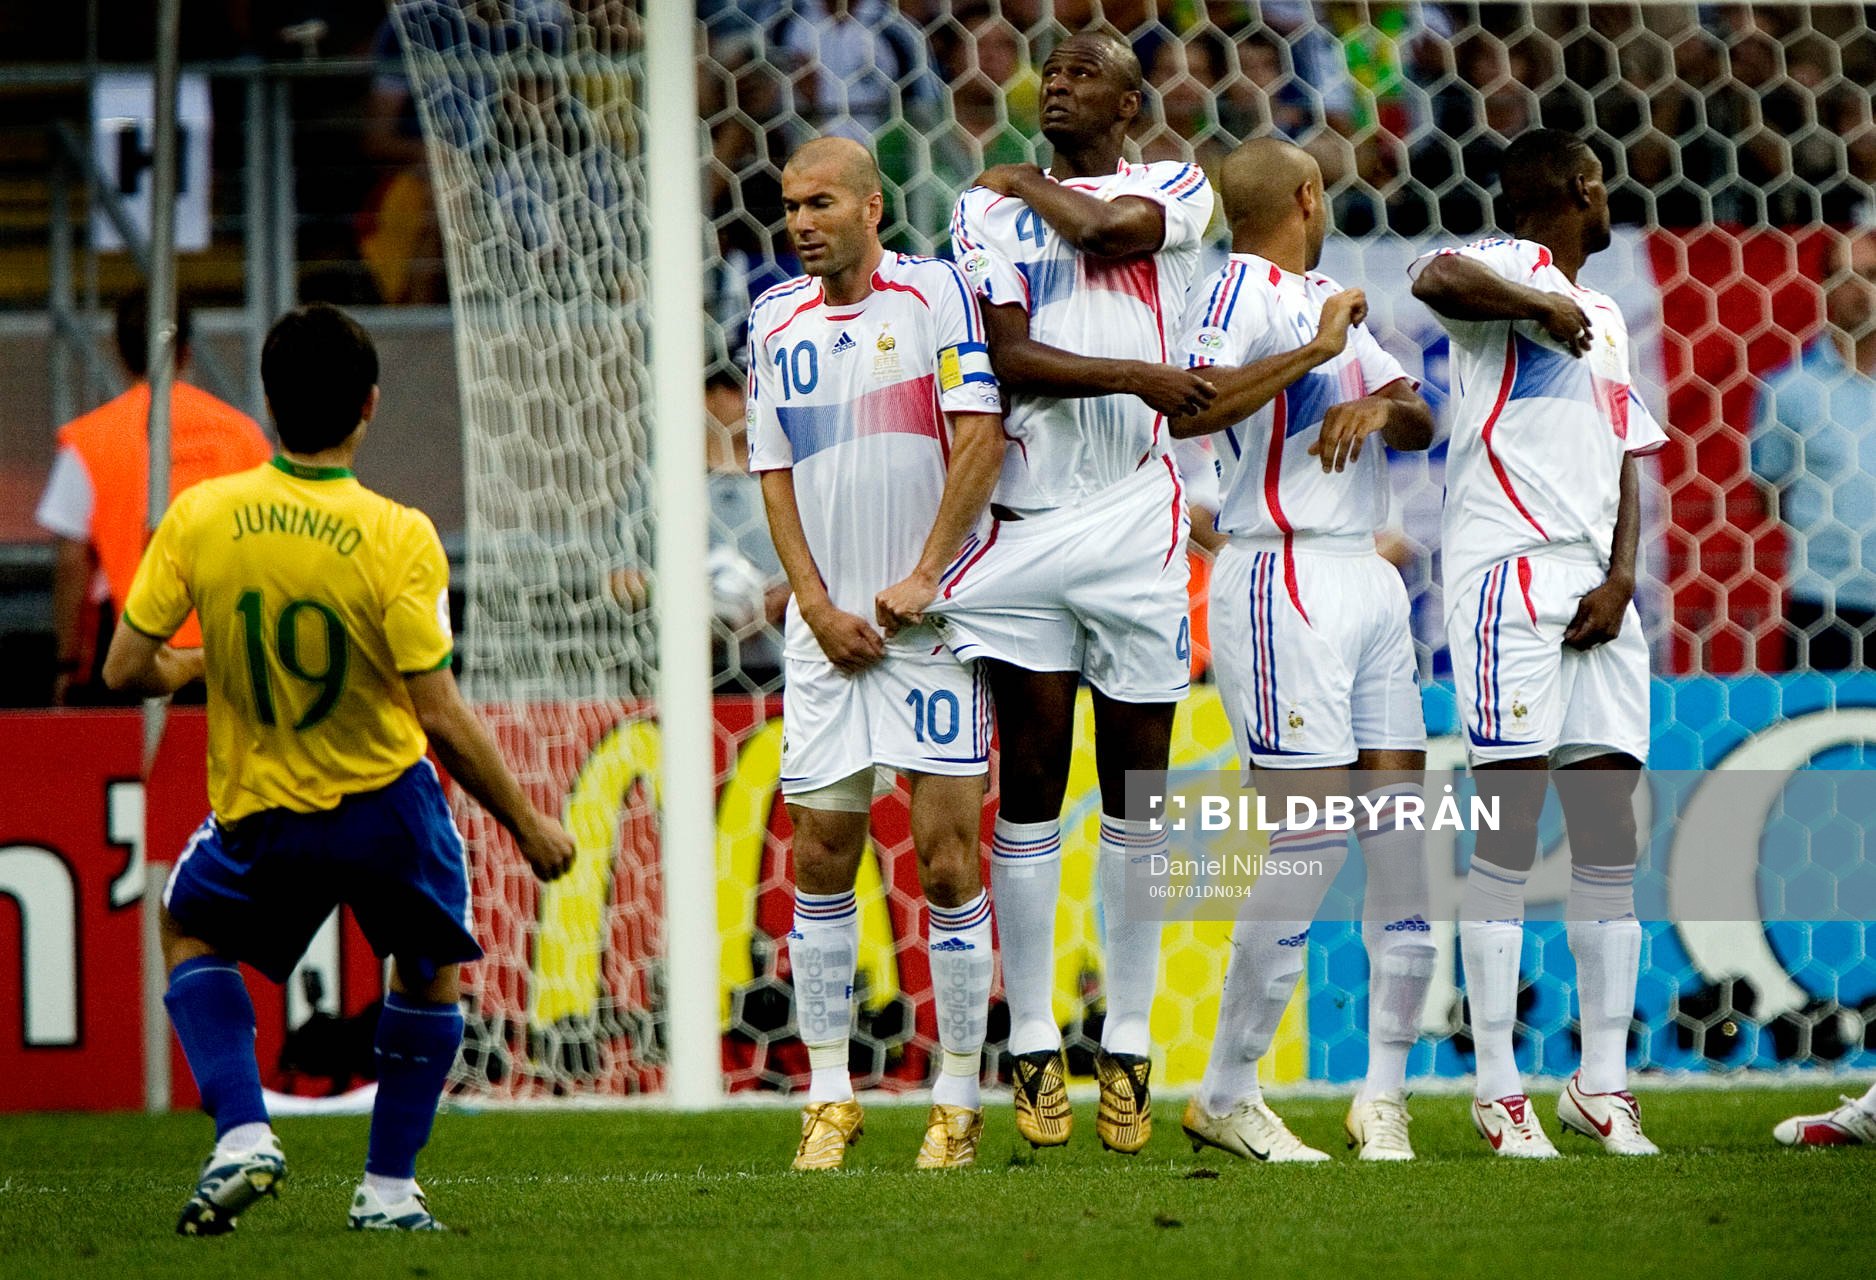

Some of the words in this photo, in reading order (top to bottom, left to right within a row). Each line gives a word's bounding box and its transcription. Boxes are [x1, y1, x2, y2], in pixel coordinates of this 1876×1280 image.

[1015, 205, 1047, 248] 4
[774, 339, 819, 401] 10
[831, 341, 857, 355] adidas
[233, 503, 362, 556] JUNINHO
[235, 588, 348, 731] 19
[1176, 615, 1190, 669] 4
[905, 688, 960, 745] 10
[930, 943, 976, 952] adidas
[1384, 920, 1431, 932] adidas
[804, 947, 827, 1034] adidas
[945, 957, 968, 1042] adidas
